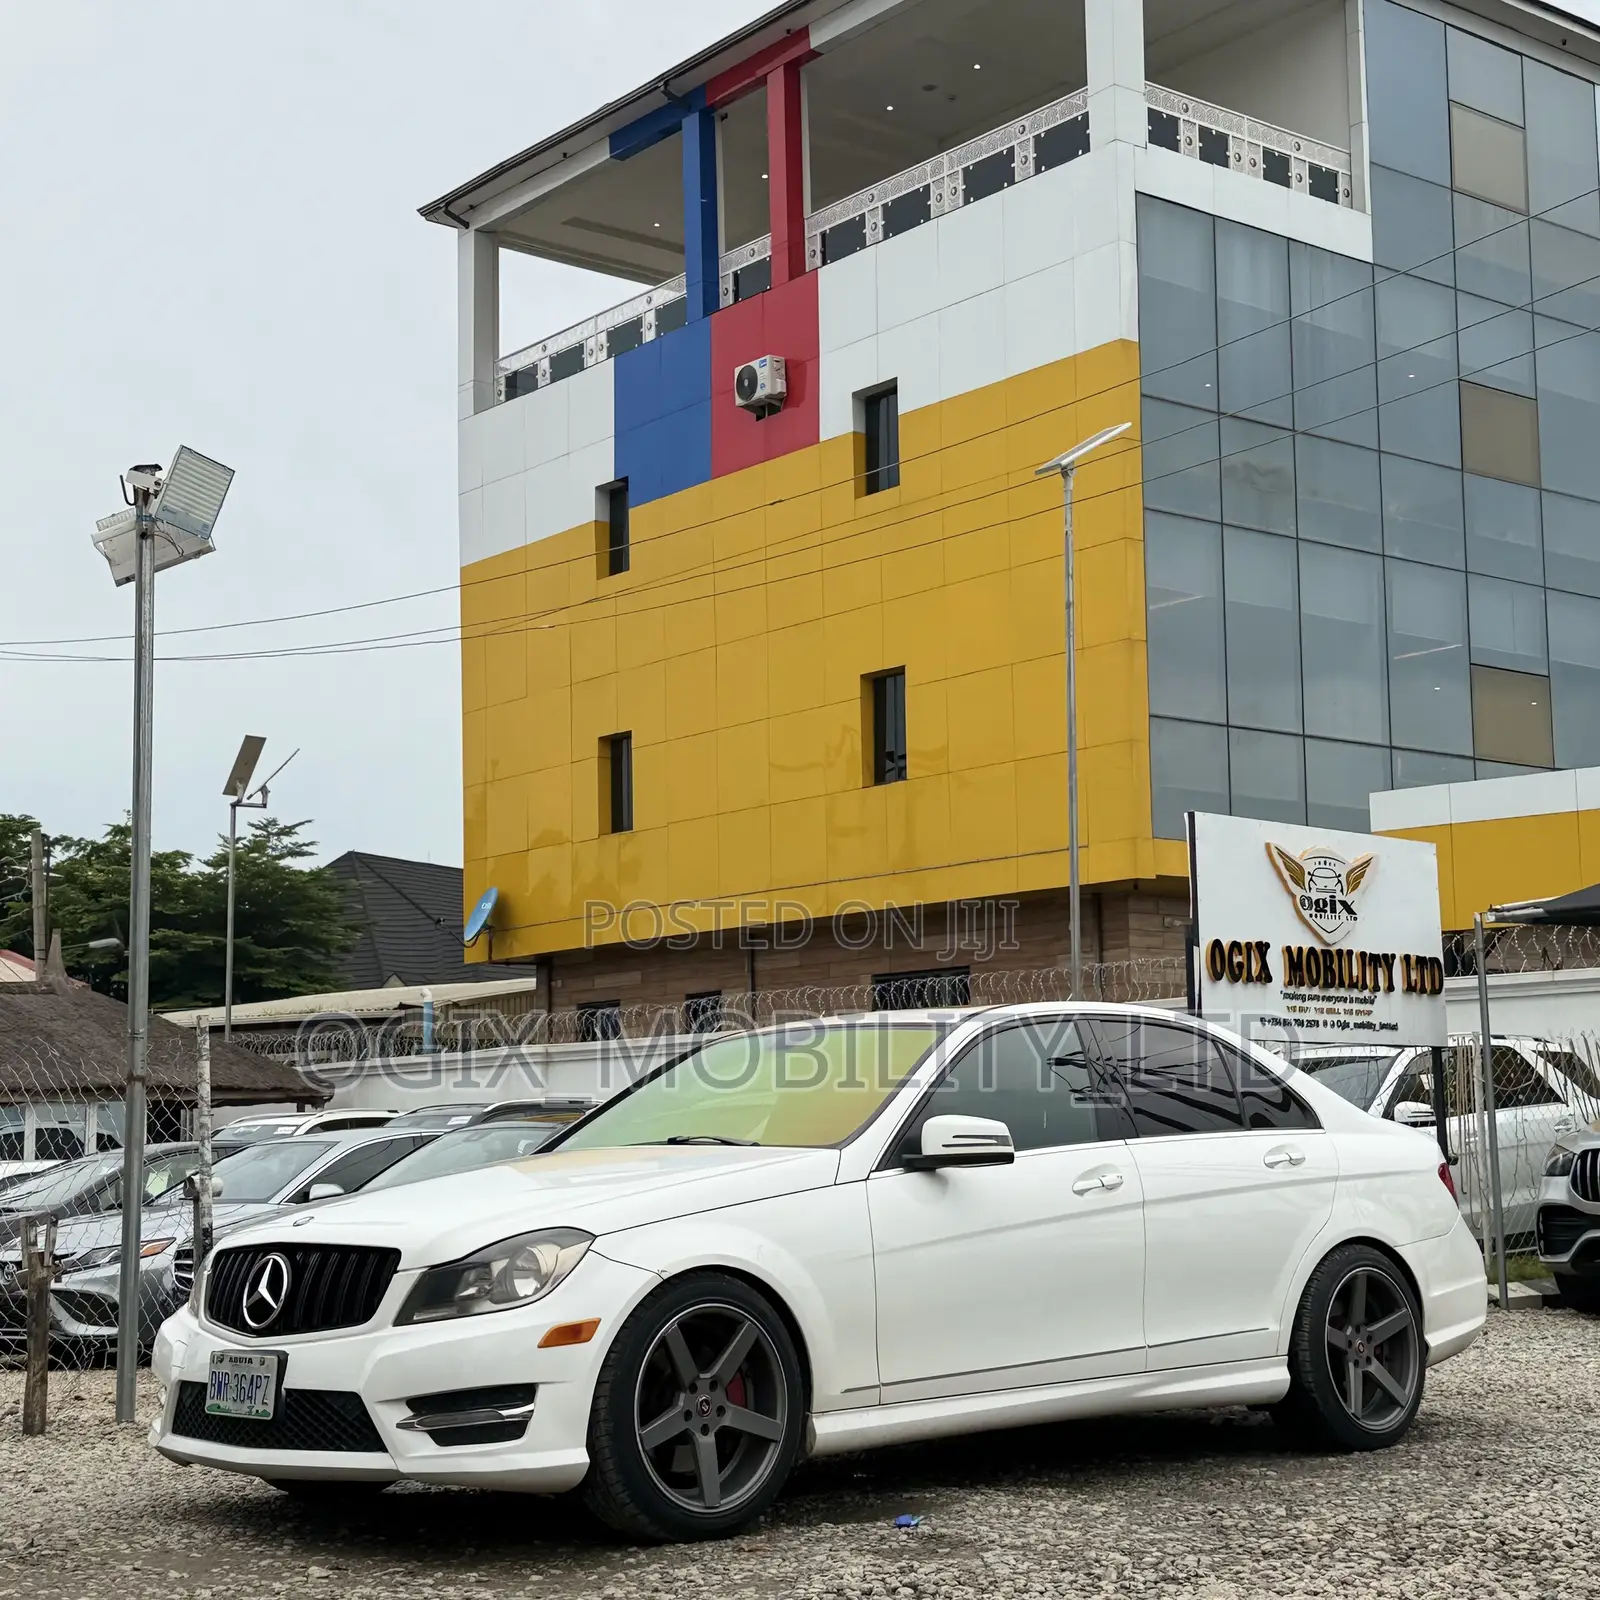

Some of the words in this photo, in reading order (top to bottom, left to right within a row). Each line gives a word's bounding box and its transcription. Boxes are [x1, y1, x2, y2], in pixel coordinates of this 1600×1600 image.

[1206, 938, 1274, 984] OGIX
[1281, 945, 1397, 993] MOBILITY
[1399, 953, 1444, 995] LTD
[228, 1356, 254, 1365] ABUJA
